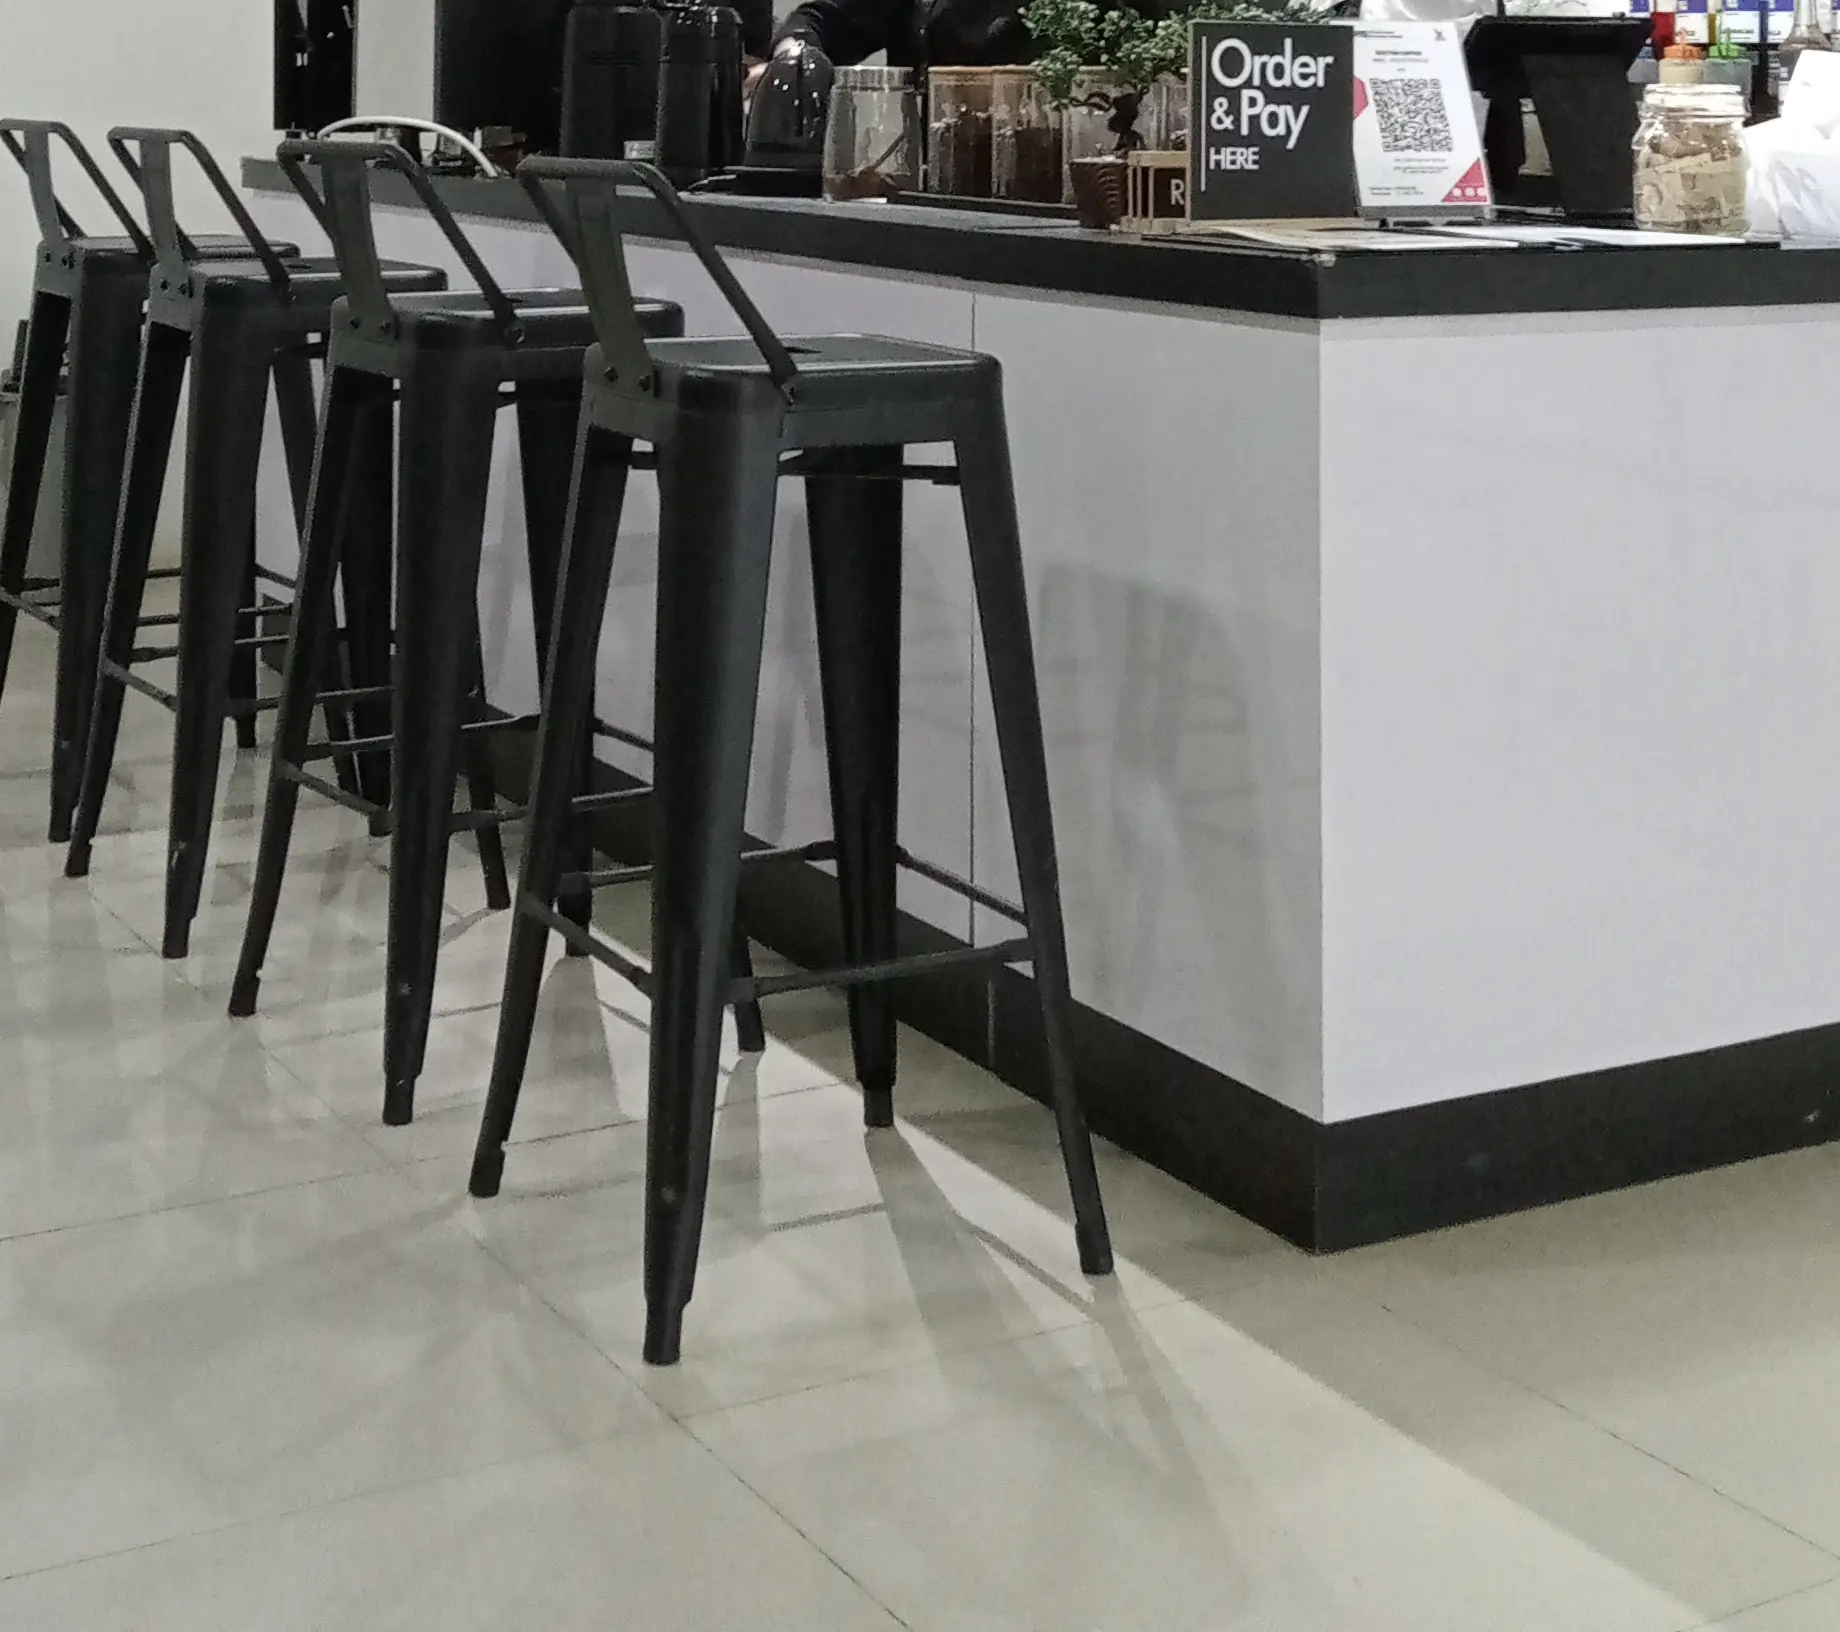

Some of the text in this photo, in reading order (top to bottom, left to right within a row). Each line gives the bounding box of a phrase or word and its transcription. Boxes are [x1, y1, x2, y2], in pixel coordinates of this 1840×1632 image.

[1210, 37, 1334, 89] Order
[1210, 89, 1310, 150] & Pay
[1209, 146, 1260, 171] HERE
